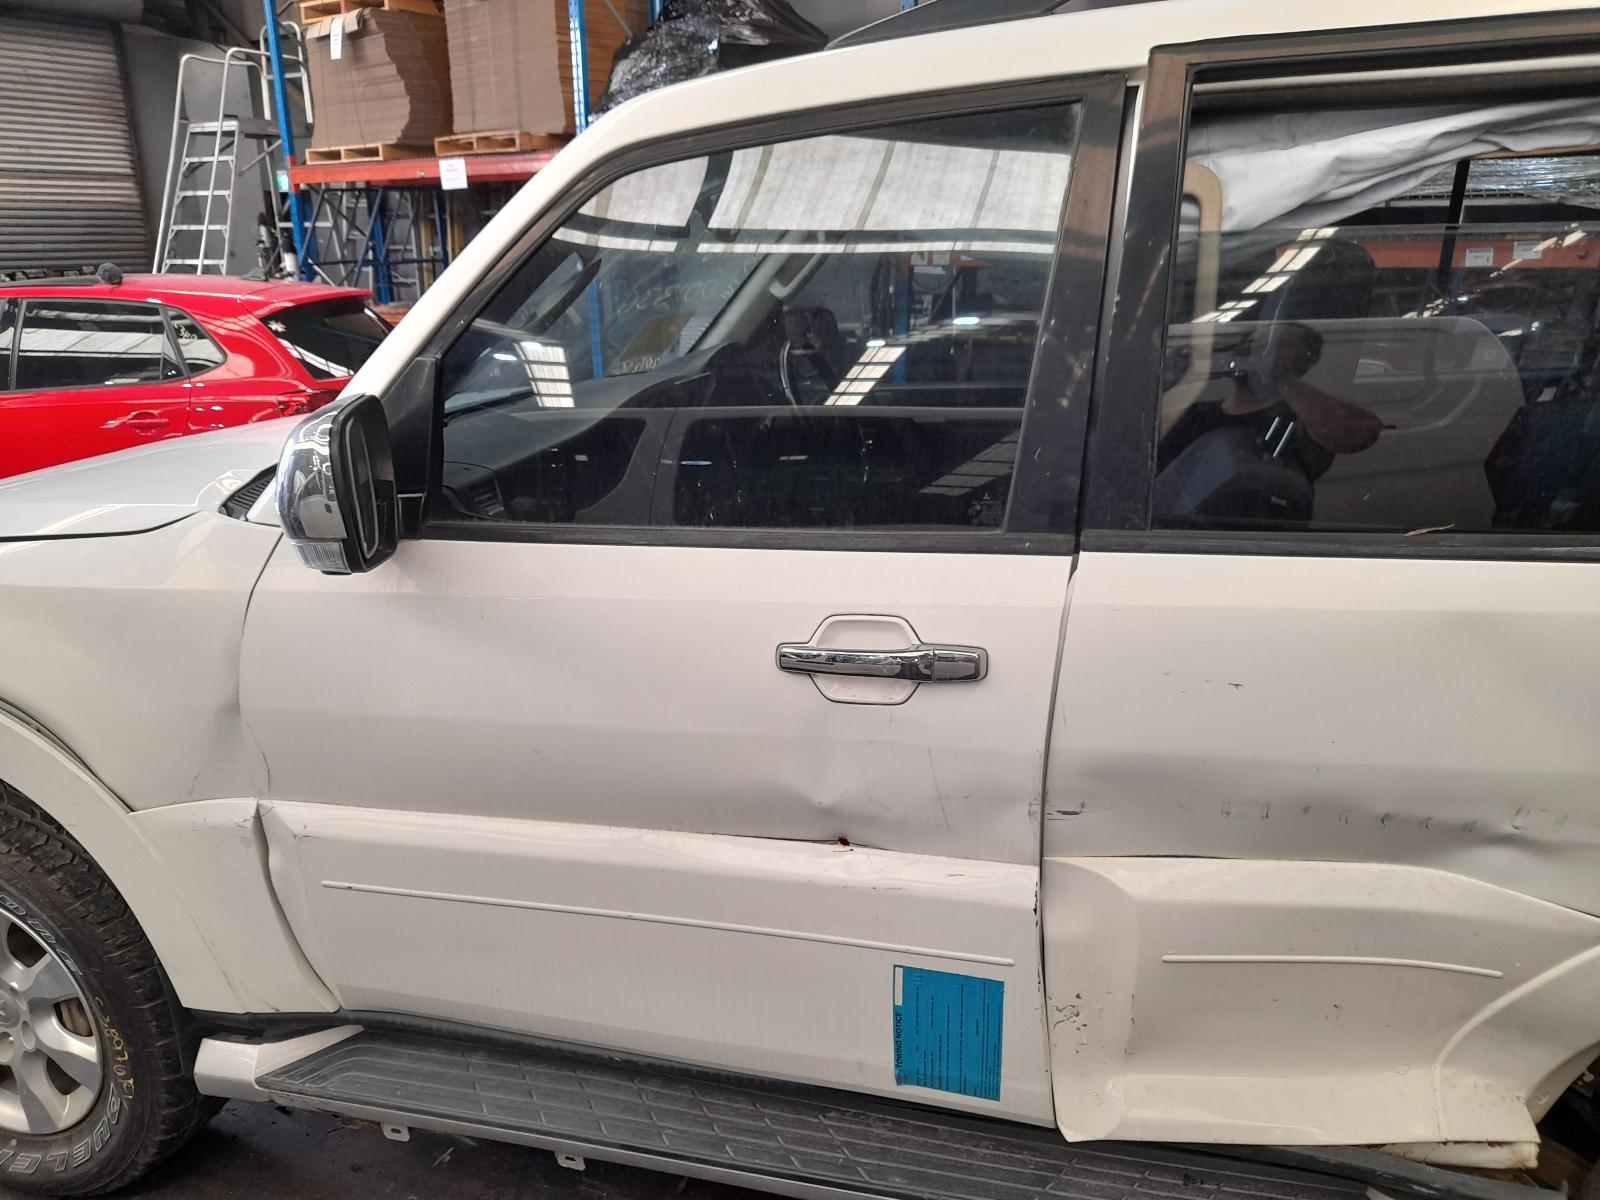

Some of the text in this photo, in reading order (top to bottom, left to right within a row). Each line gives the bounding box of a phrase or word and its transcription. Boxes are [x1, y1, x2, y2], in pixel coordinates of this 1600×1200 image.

[895, 1011, 903, 1069] TOWING NOTICE
[0, 1082, 120, 1174] DUELE
